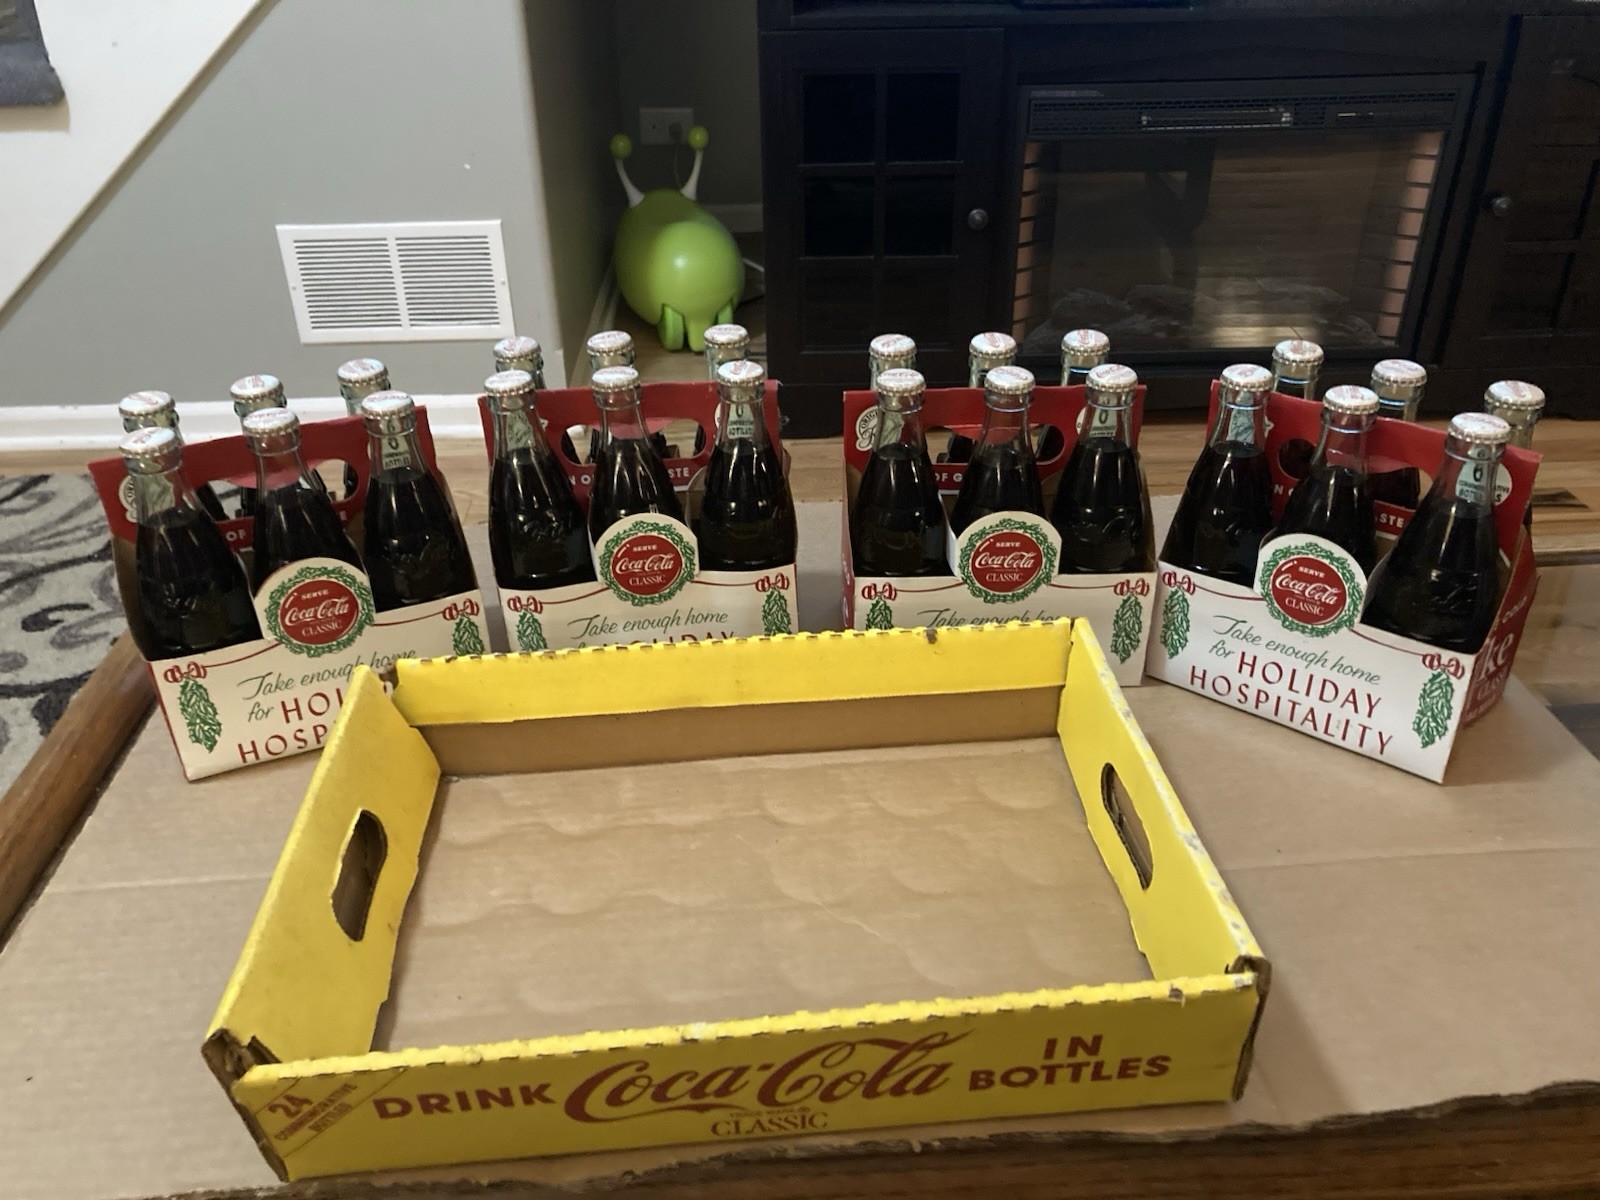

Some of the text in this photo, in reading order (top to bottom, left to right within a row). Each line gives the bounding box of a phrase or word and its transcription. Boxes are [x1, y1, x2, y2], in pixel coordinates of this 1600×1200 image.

[632, 544, 657, 552] SERVE
[974, 551, 1037, 569] Coca-Cola
[615, 552, 675, 574] Coca-Cola
[1298, 566, 1325, 578] SERVE
[628, 575, 666, 586] CLASSIC
[985, 572, 1023, 582] CLASSIC
[1275, 573, 1342, 605] Coca-Cola
[302, 589, 329, 600] SERVE
[1285, 597, 1324, 616] CLASSIC
[285, 596, 349, 626] Coca-Cola
[567, 614, 617, 640] Take
[622, 608, 681, 634] enough
[684, 607, 728, 626] home
[302, 620, 342, 637] CLASSIC
[1212, 614, 1382, 686] Take enough home
[236, 671, 295, 701] Take
[1209, 640, 1382, 719] for HOLIDAY
[248, 702, 274, 723] for
[1190, 665, 1394, 757] HOSPITALITY
[1044, 1034, 1105, 1060] IN
[563, 1029, 976, 1123] Coca-Cola
[968, 1055, 1173, 1092] BOTTLES
[373, 1082, 557, 1120] DRINK
[710, 1111, 828, 1137] CLASSIC
